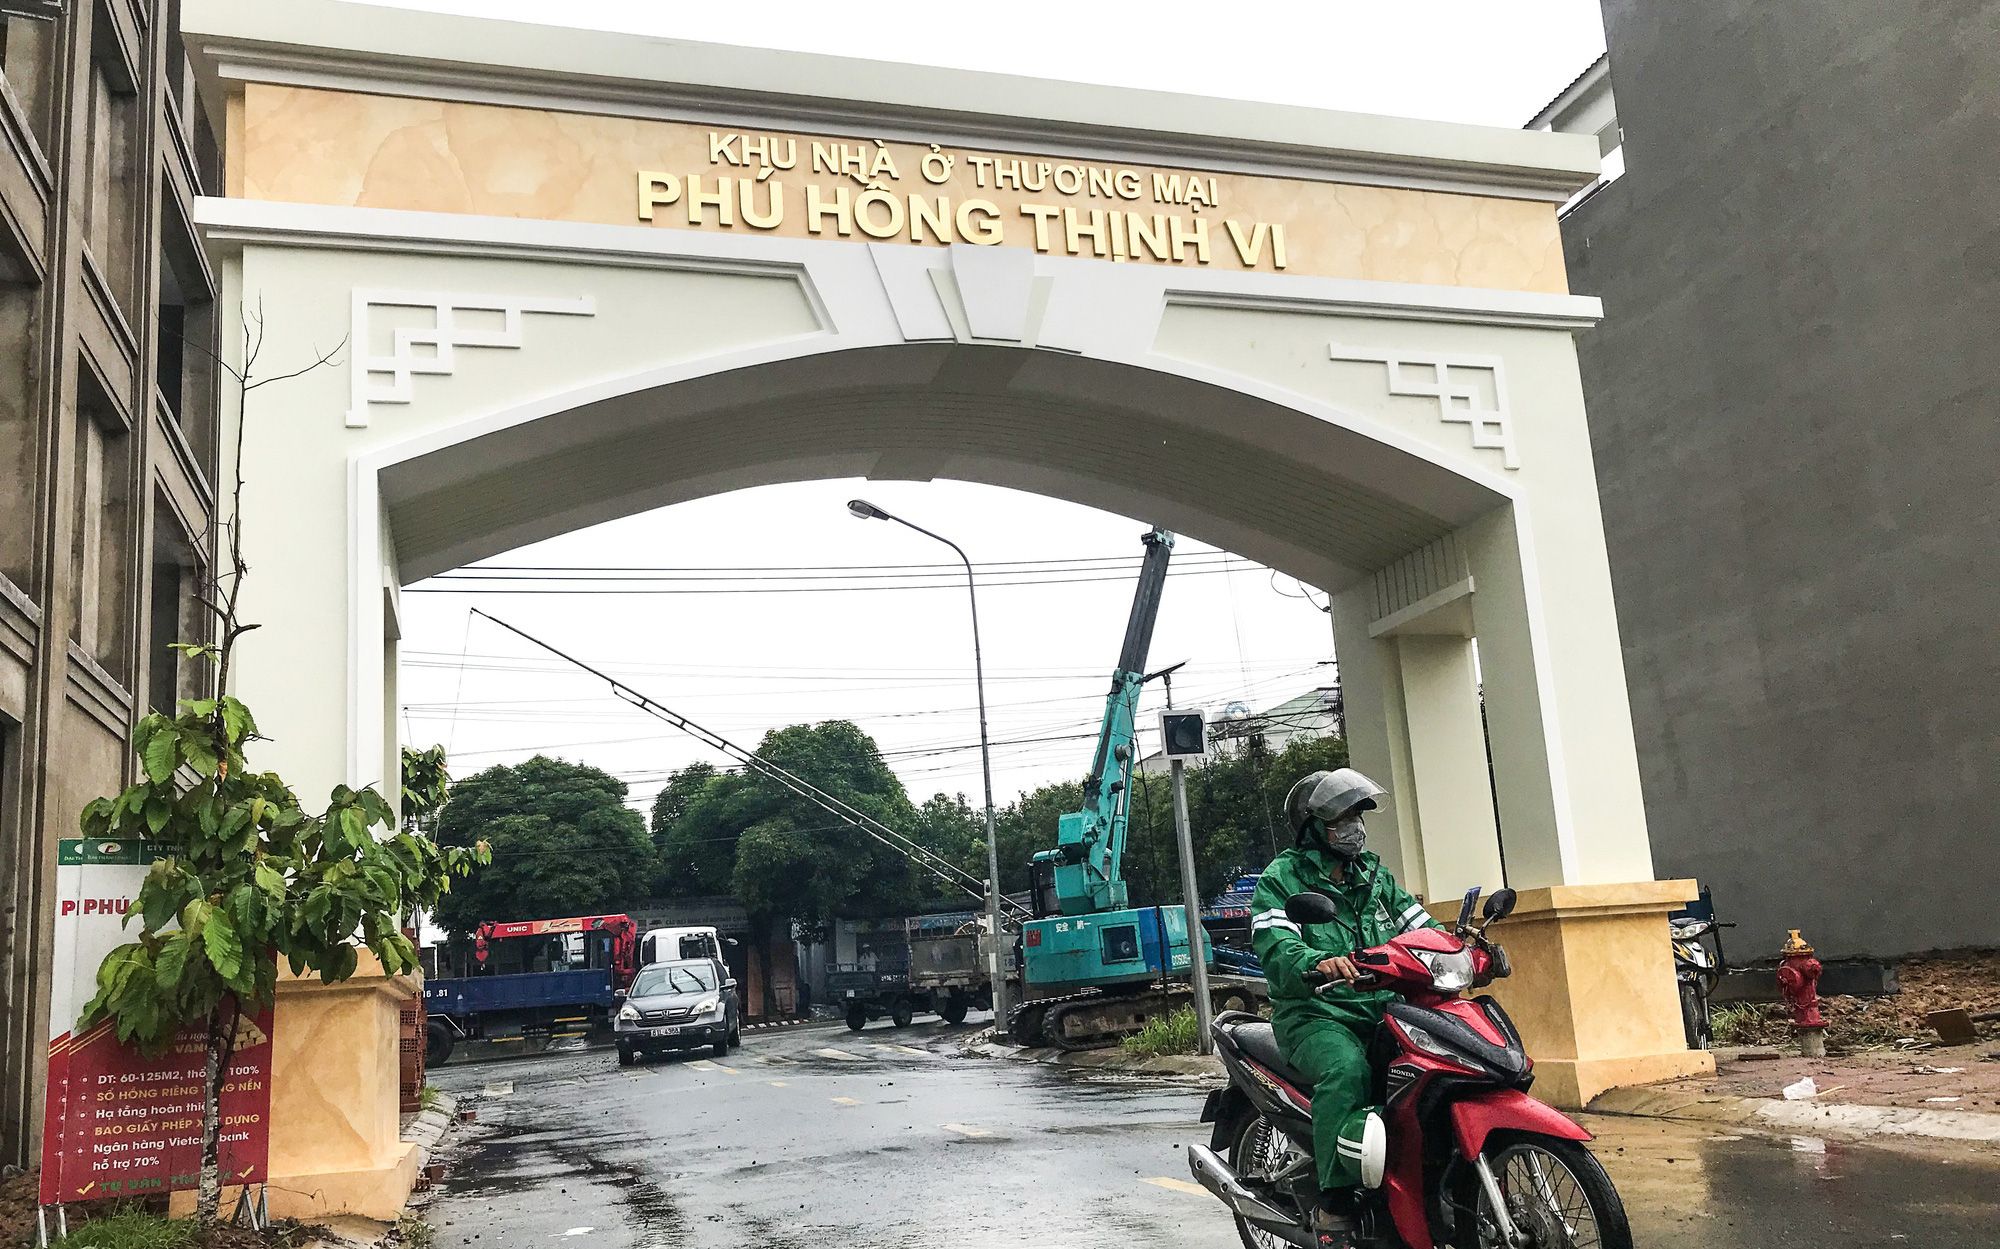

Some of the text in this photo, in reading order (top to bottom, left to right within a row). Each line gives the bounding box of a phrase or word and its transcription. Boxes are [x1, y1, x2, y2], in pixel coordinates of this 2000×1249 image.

[709, 131, 1219, 214] KHU NHÀ Ở THƯƠNG MẠI
[637, 167, 1287, 269] PHÚ HỒNG THỊNH VI
[83, 895, 130, 915] PHÚ
[506, 925, 528, 933] UNIC
[97, 1065, 260, 1085] DT: 60-125M2, thổ 100%
[1390, 1068, 1417, 1079] HONDA
[96, 1087, 115, 1102] SỔ
[119, 1086, 158, 1100] HỒNG
[161, 1084, 199, 1097] RIÊNG
[238, 1077, 262, 1091] NỀN
[95, 1109, 115, 1120] Hạ
[118, 1105, 147, 1118] tầng
[150, 1103, 183, 1115] hoàn
[94, 1124, 123, 1136] BAO
[126, 1119, 158, 1133] GIẤY
[161, 1117, 193, 1131] PHÉP
[225, 1114, 260, 1127] DỰNG
[93, 1142, 129, 1156] Ngân
[132, 1139, 165, 1151] hàng
[92, 1156, 160, 1171] hỗ trợ 70%
